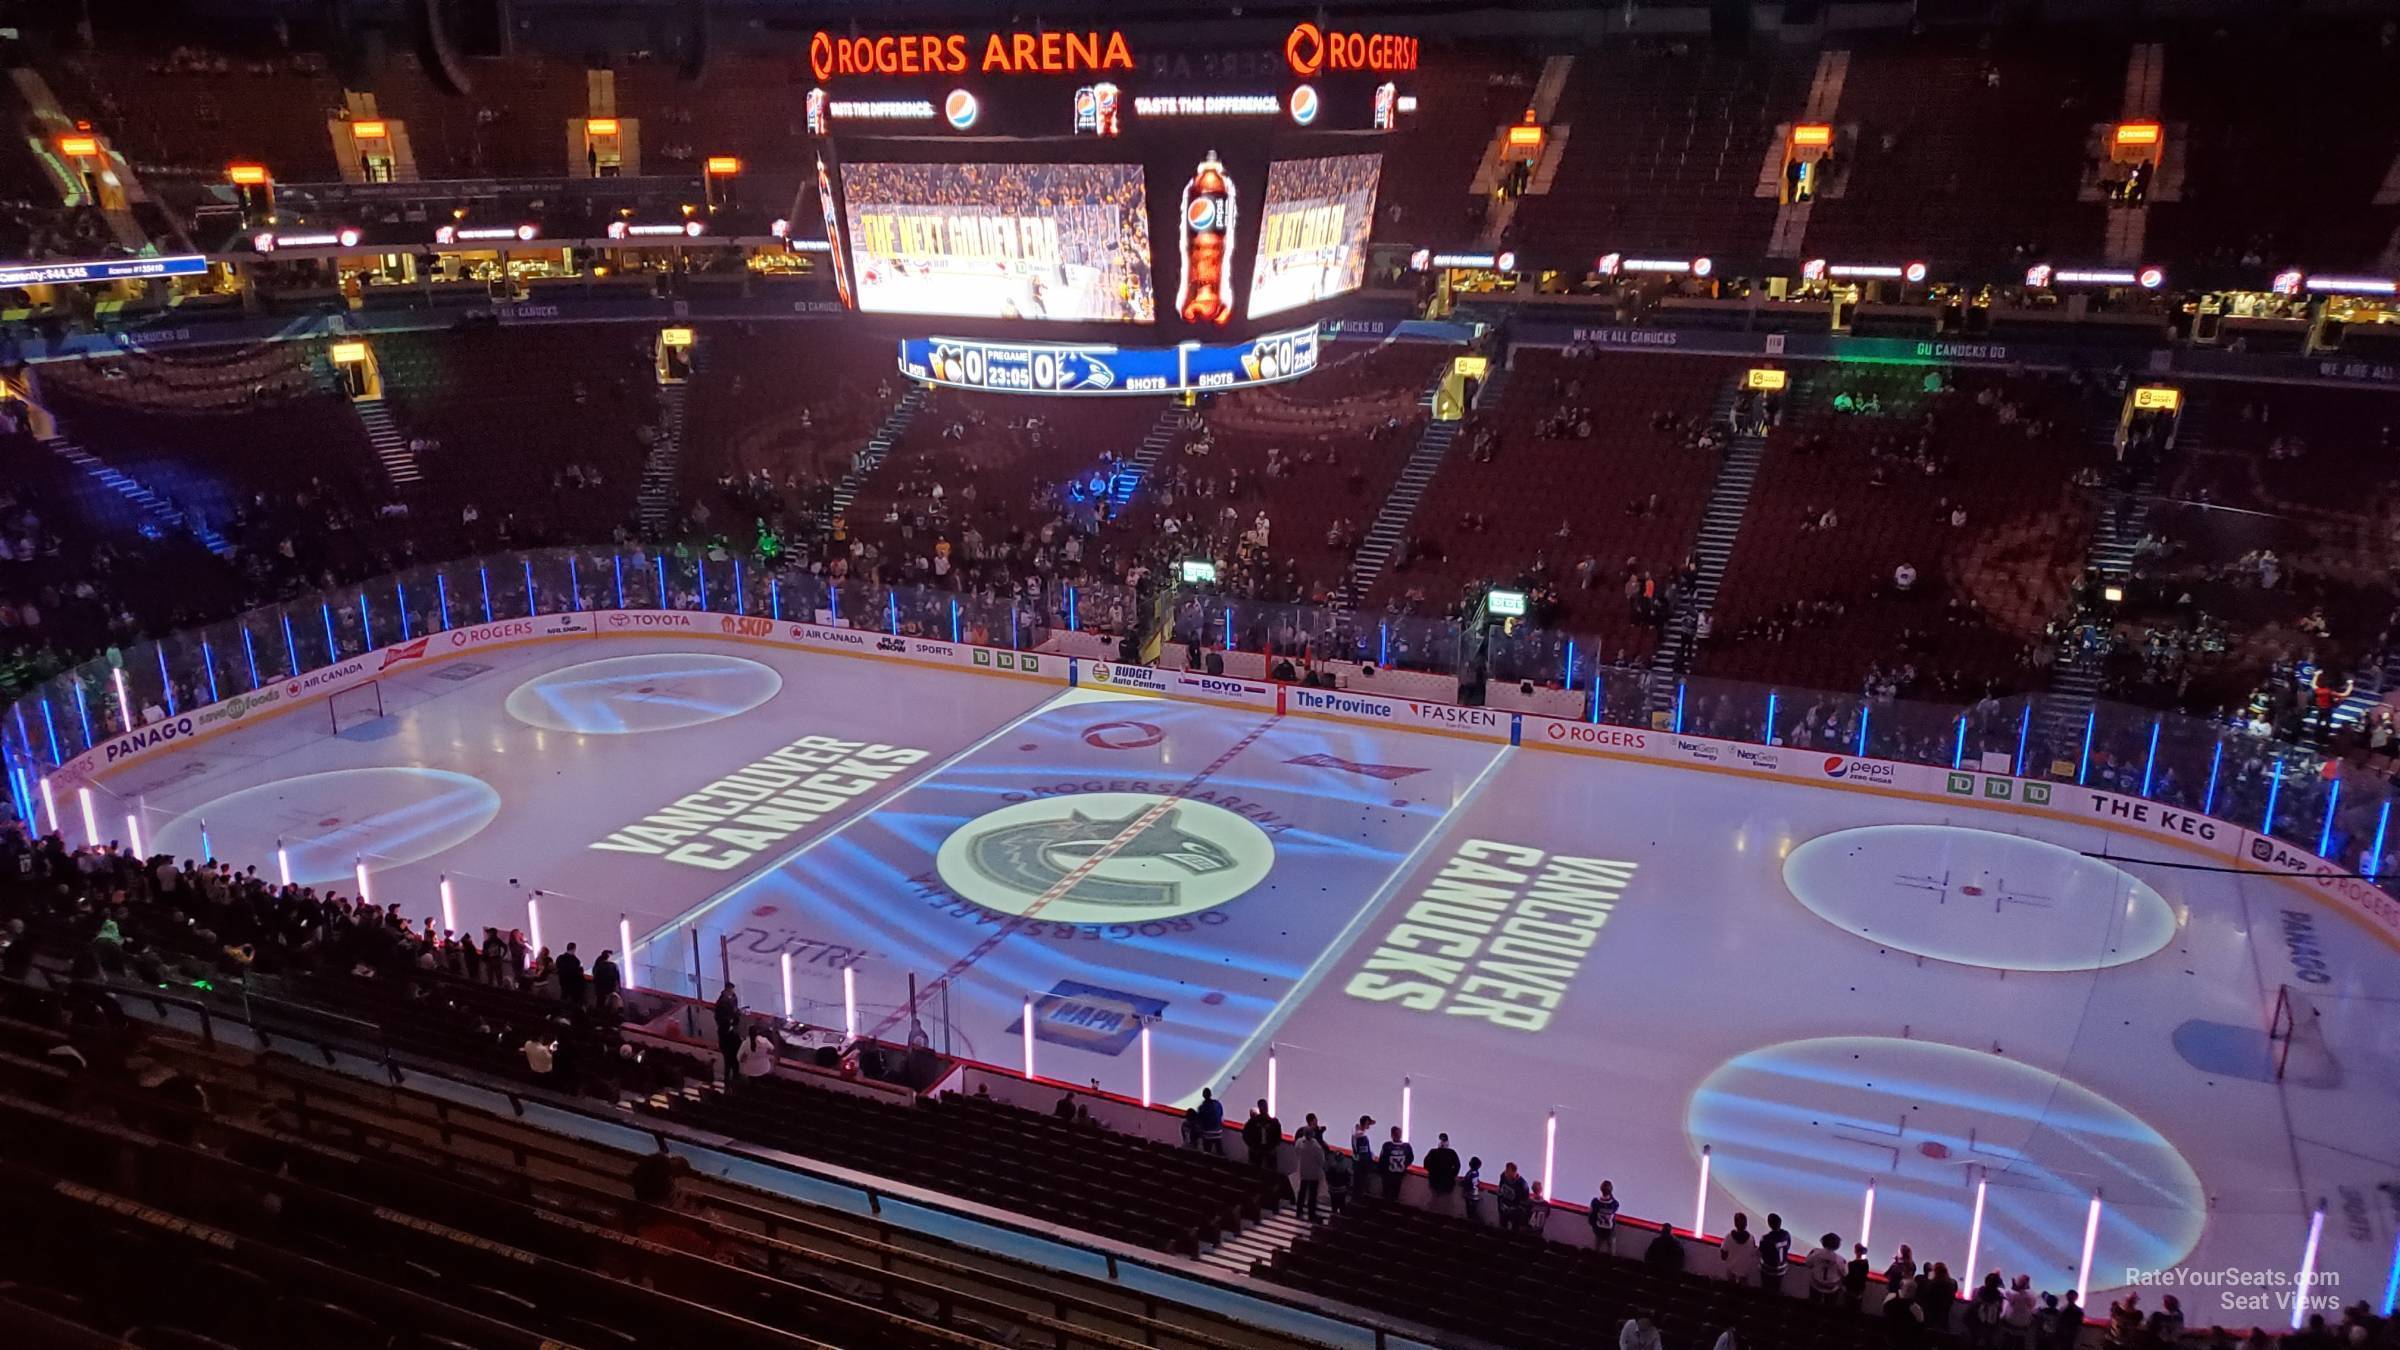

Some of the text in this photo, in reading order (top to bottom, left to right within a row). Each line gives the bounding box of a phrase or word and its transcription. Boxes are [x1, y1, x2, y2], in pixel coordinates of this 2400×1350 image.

[838, 34, 969, 74] ROGERS
[982, 31, 1134, 71] ARENA
[1330, 32, 1411, 70] ROGERS
[1135, 96, 1280, 113] TASTE THE DIFFERENCE.
[861, 215, 1062, 263] THE NEXT GOLDEN ERA
[1329, 321, 1370, 333] CANUCKS
[1371, 322, 1384, 334] GO
[1573, 329, 1677, 345] WE ARE ALL CANUCKS
[987, 350, 1028, 361] PREGAME
[1279, 342, 1291, 371] 0
[1917, 342, 1932, 356] GO
[1935, 344, 1987, 358] CANUCKS
[965, 351, 1054, 387] 0 23:05 0
[2320, 362, 2394, 379] WE ARE ALL
[1126, 378, 1166, 390] SHOTS
[1199, 373, 1235, 387] SHOTS
[633, 613, 691, 627] TOYOTA
[736, 616, 774, 637] SKIP
[471, 621, 534, 642] ROGERS
[805, 629, 864, 645] AIR CANADA
[882, 637, 906, 645] PLAY
[883, 643, 906, 653] NOW
[916, 644, 954, 656] SPORTS
[975, 651, 989, 663] TD
[1000, 654, 1013, 666] TD
[1024, 658, 1038, 670] TD
[302, 661, 364, 690] AIR CANADA
[1115, 665, 1154, 681] BUDGET
[1113, 676, 1167, 691] Auto Centres
[1201, 679, 1243, 693] BOYD
[198, 709, 226, 726] save
[245, 688, 281, 711] foods
[1296, 690, 1392, 718] The Province
[1422, 704, 1496, 726] FASKEN
[106, 717, 195, 763] PANAGO
[1570, 726, 1646, 748] ROGERS
[1677, 738, 1719, 755] NexGen
[1693, 751, 1718, 761] Energy
[1737, 749, 1778, 763] NexGen
[1752, 760, 1777, 770] Energy
[1850, 761, 1895, 776] pepsi
[1032, 780, 1178, 797] ROGERS
[1951, 775, 1973, 792] TD
[1989, 780, 2010, 797] TD
[588, 735, 866, 855] VANCOUVER
[2028, 785, 2049, 801] TD
[664, 743, 932, 870] CANUCKS
[1195, 786, 1295, 834] ARENA
[2091, 794, 2217, 841] THE KEG
[2338, 877, 2400, 930] ROGERS
[1022, 918, 1195, 941] ROGERS
[1345, 838, 1546, 1011] CANUCKS
[1445, 855, 1639, 1032] VANCOUVER
[2280, 909, 2332, 984] PANAGO
[1046, 999, 1125, 1031] NAPA
